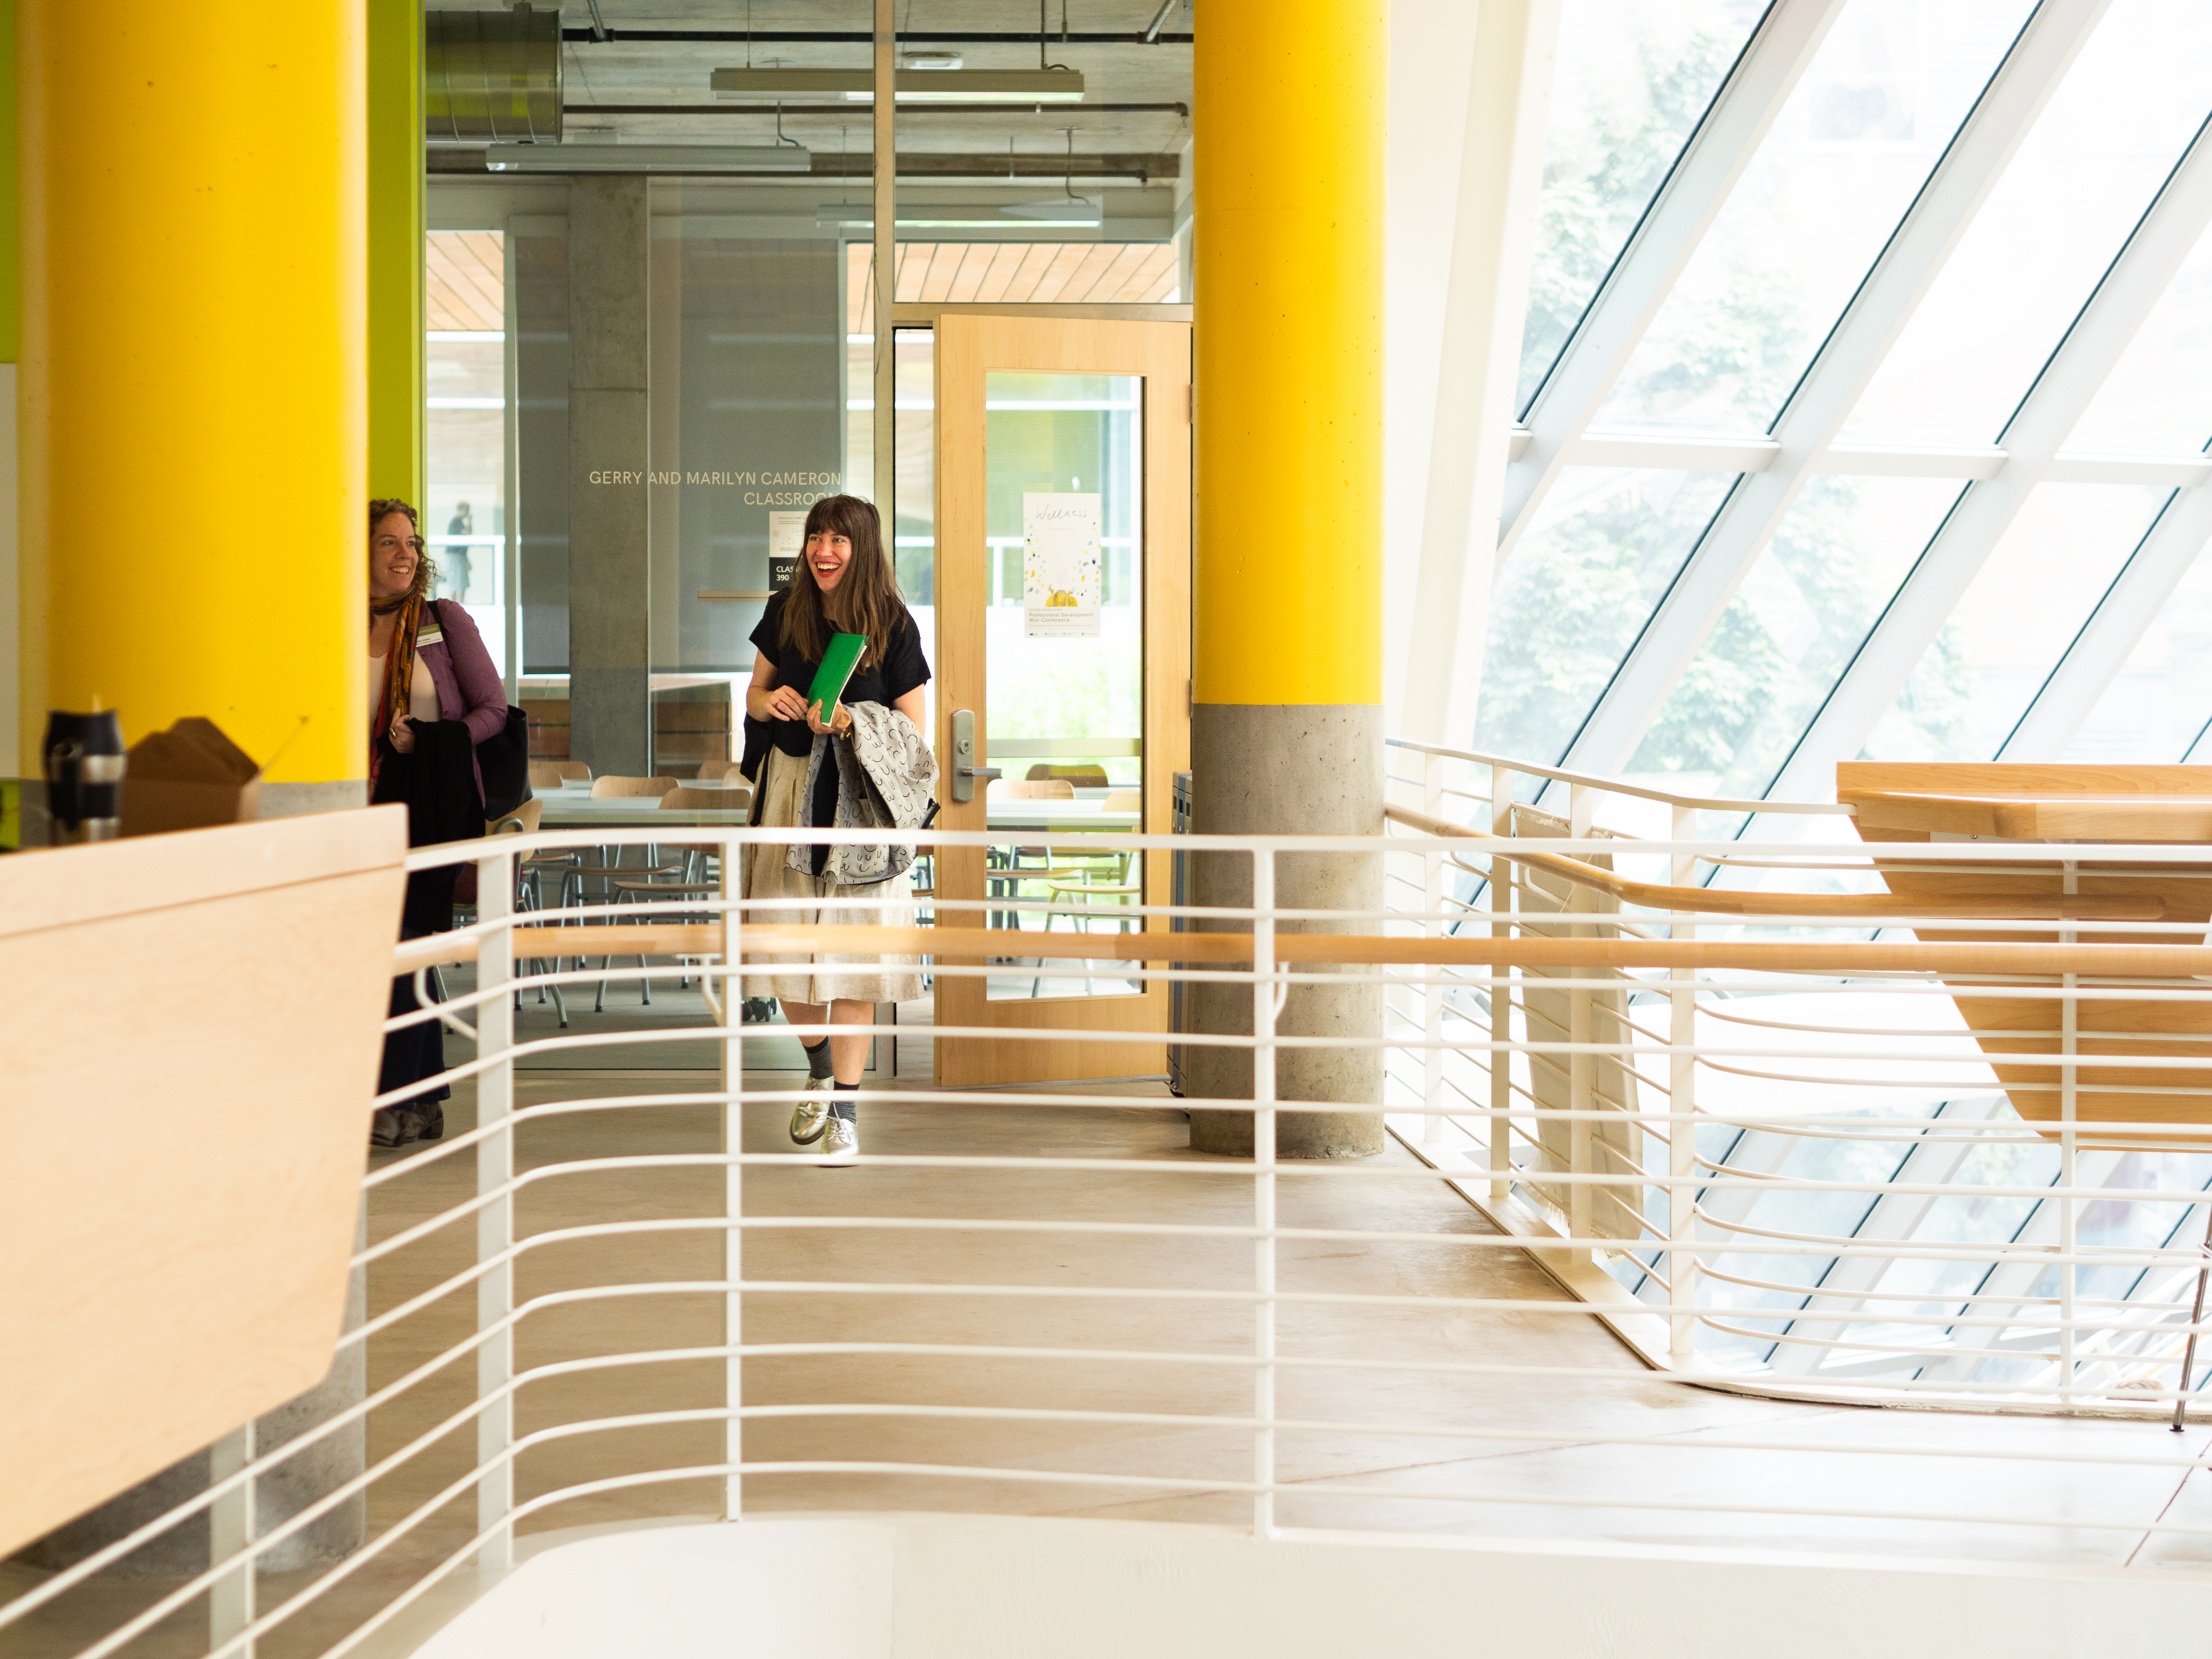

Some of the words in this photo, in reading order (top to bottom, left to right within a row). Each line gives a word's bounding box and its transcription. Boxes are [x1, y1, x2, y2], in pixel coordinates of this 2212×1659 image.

[589, 471, 643, 485] GERRY
[648, 471, 681, 485] AND
[687, 472, 756, 485] MARILYN
[761, 472, 841, 486] CAMERON
[744, 492, 841, 505] CLASSROO
[1036, 504, 1087, 520] Wellness
